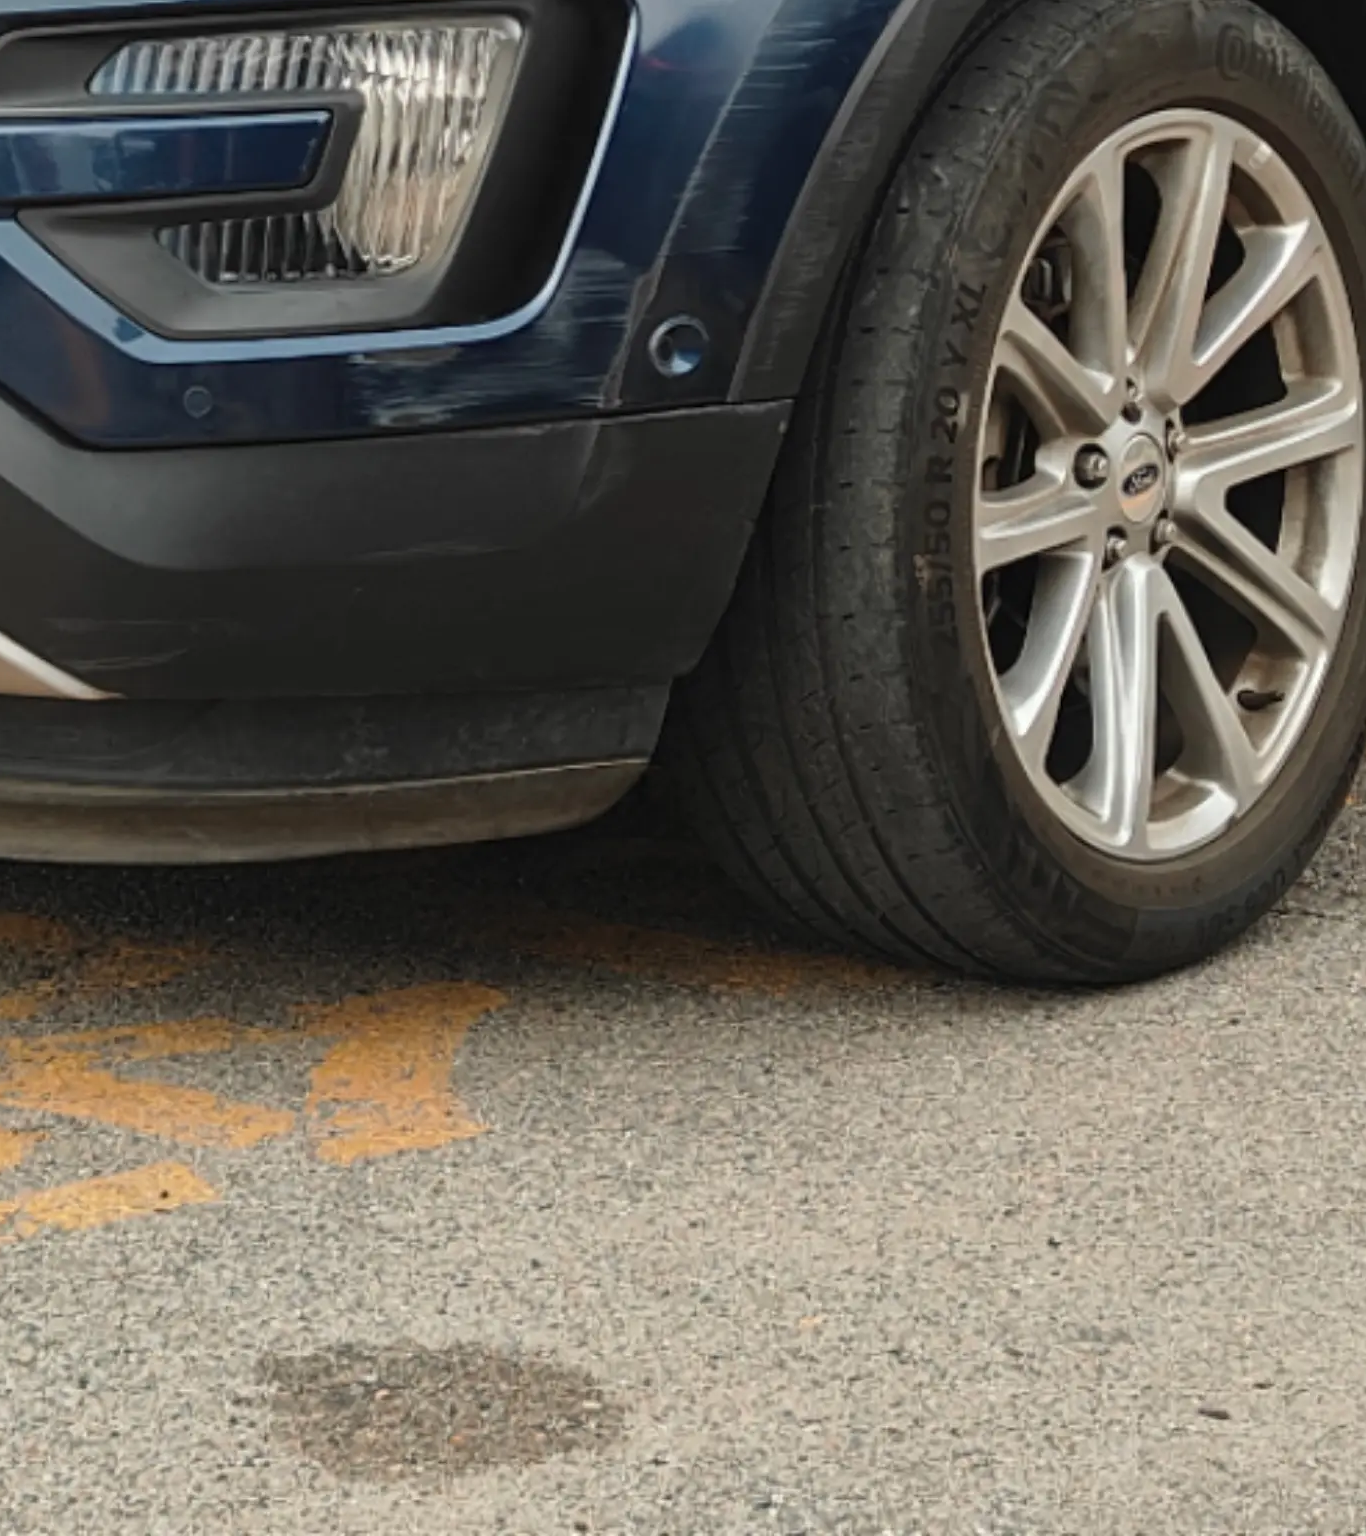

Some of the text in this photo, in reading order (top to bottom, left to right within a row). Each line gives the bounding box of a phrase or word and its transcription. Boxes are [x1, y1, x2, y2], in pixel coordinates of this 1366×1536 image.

[950, 281, 988, 332] XL
[940, 338, 969, 367] Y
[931, 387, 960, 445] 20
[925, 456, 955, 484] R
